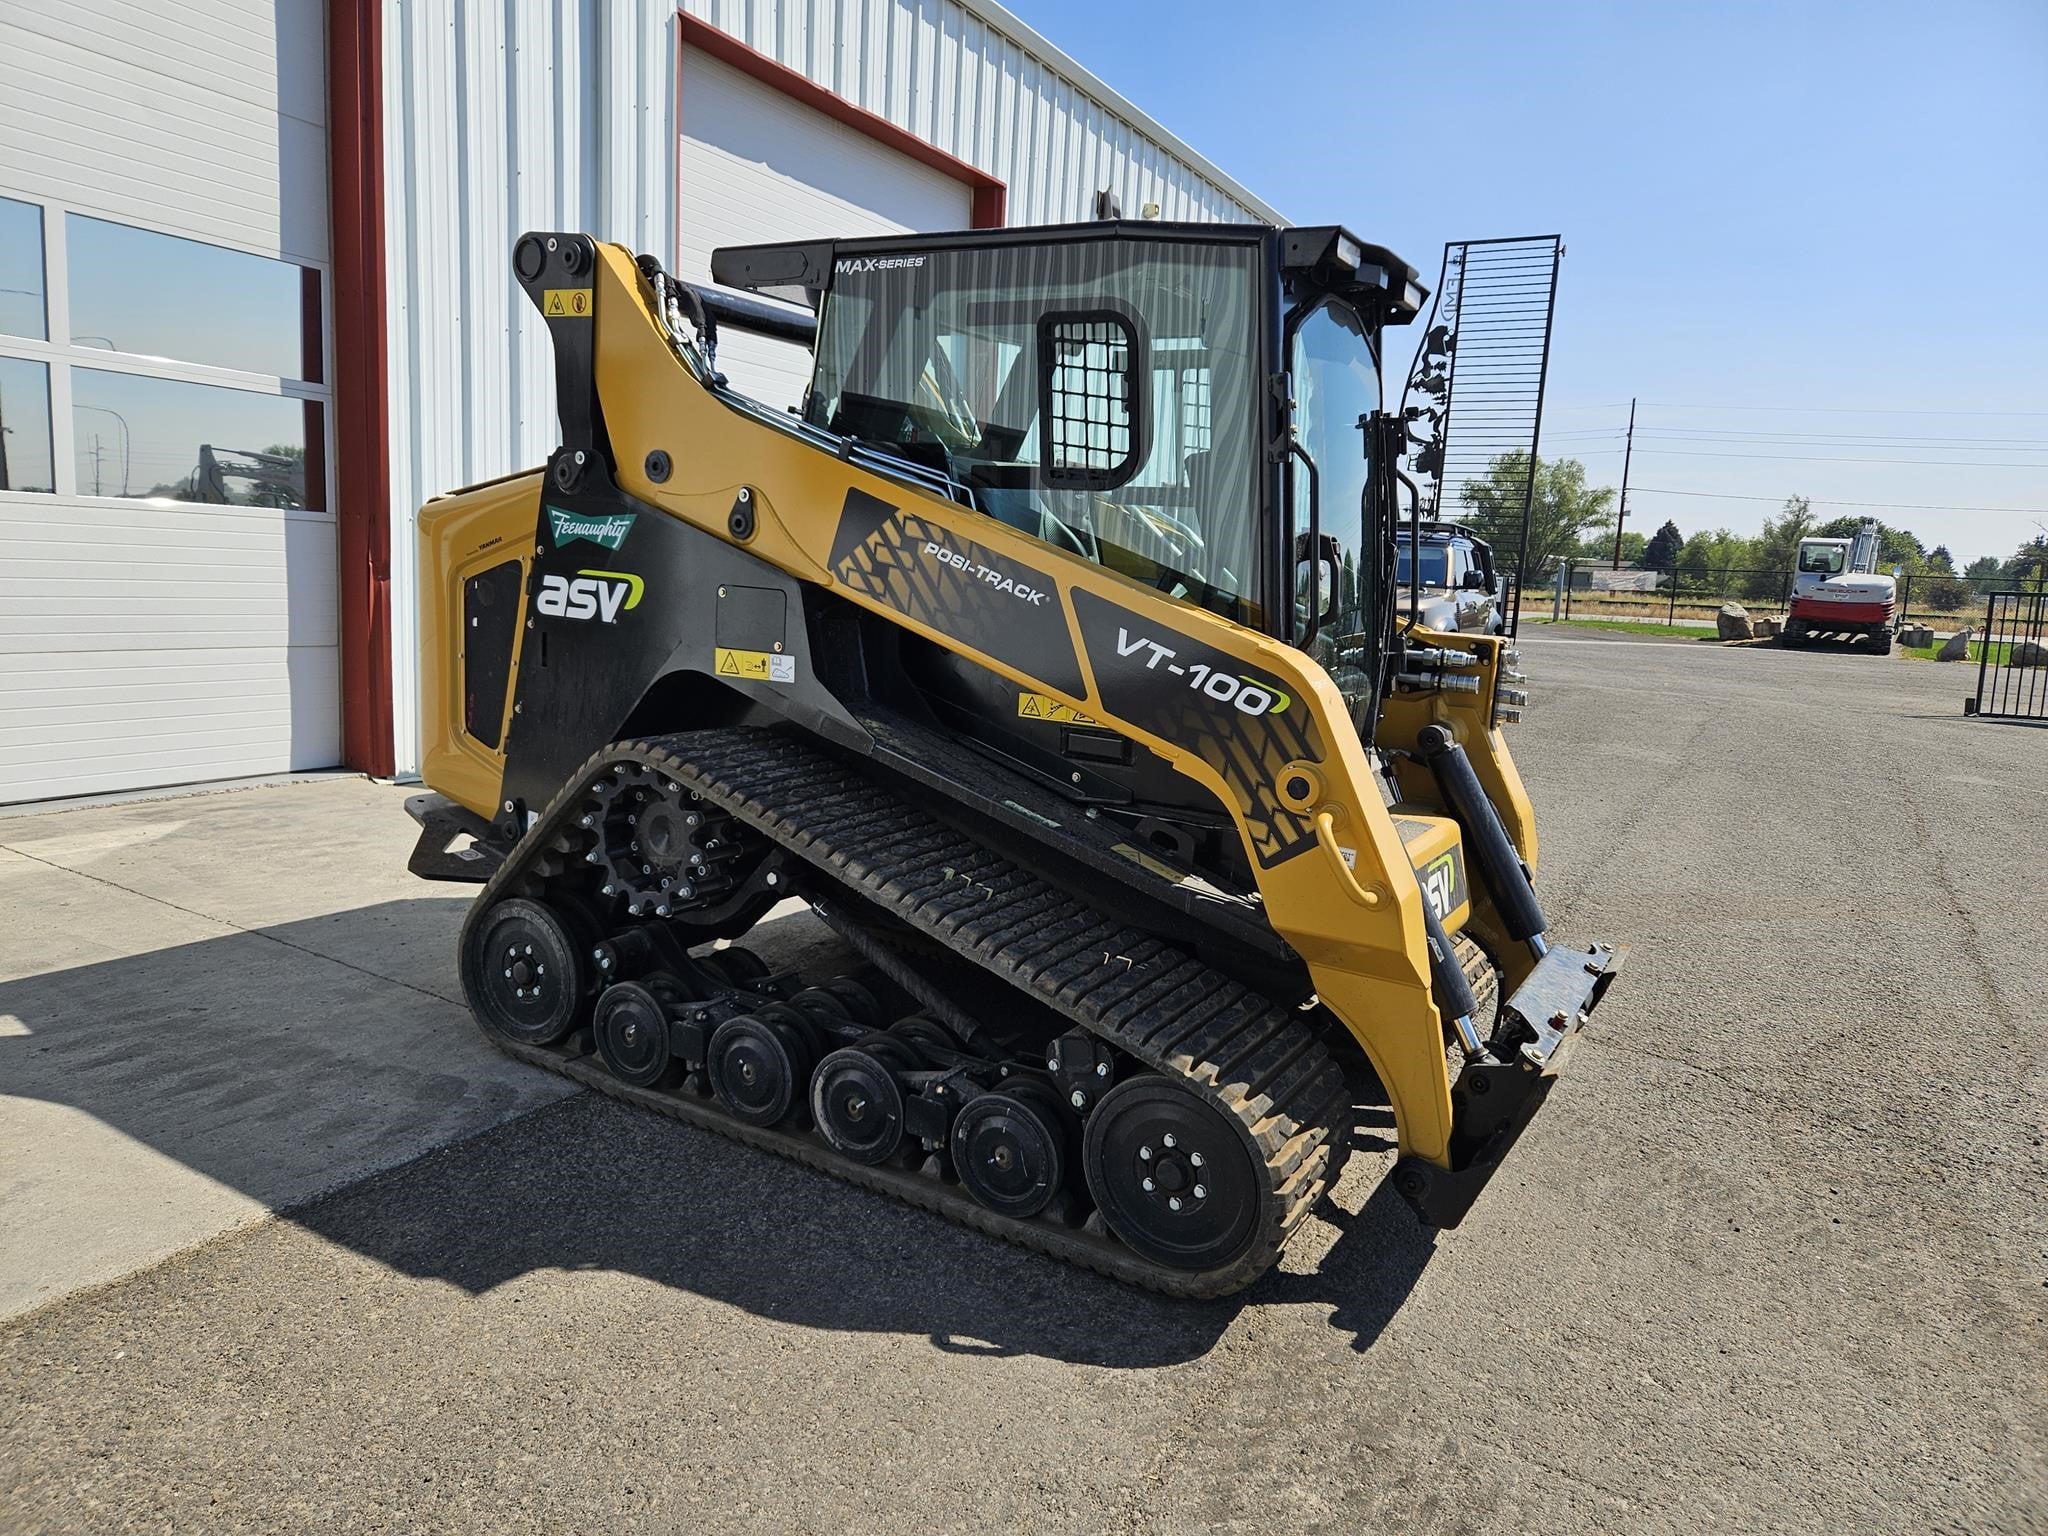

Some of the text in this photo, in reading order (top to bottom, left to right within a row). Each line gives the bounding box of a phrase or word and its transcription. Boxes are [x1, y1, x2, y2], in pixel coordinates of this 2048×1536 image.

[834, 256, 925, 275] MAX-SERIES
[478, 536, 503, 550] YANMAR
[551, 509, 631, 549] Feenaughty
[923, 541, 1047, 606] POSI-TRACK
[1115, 627, 1272, 717] VT-100
